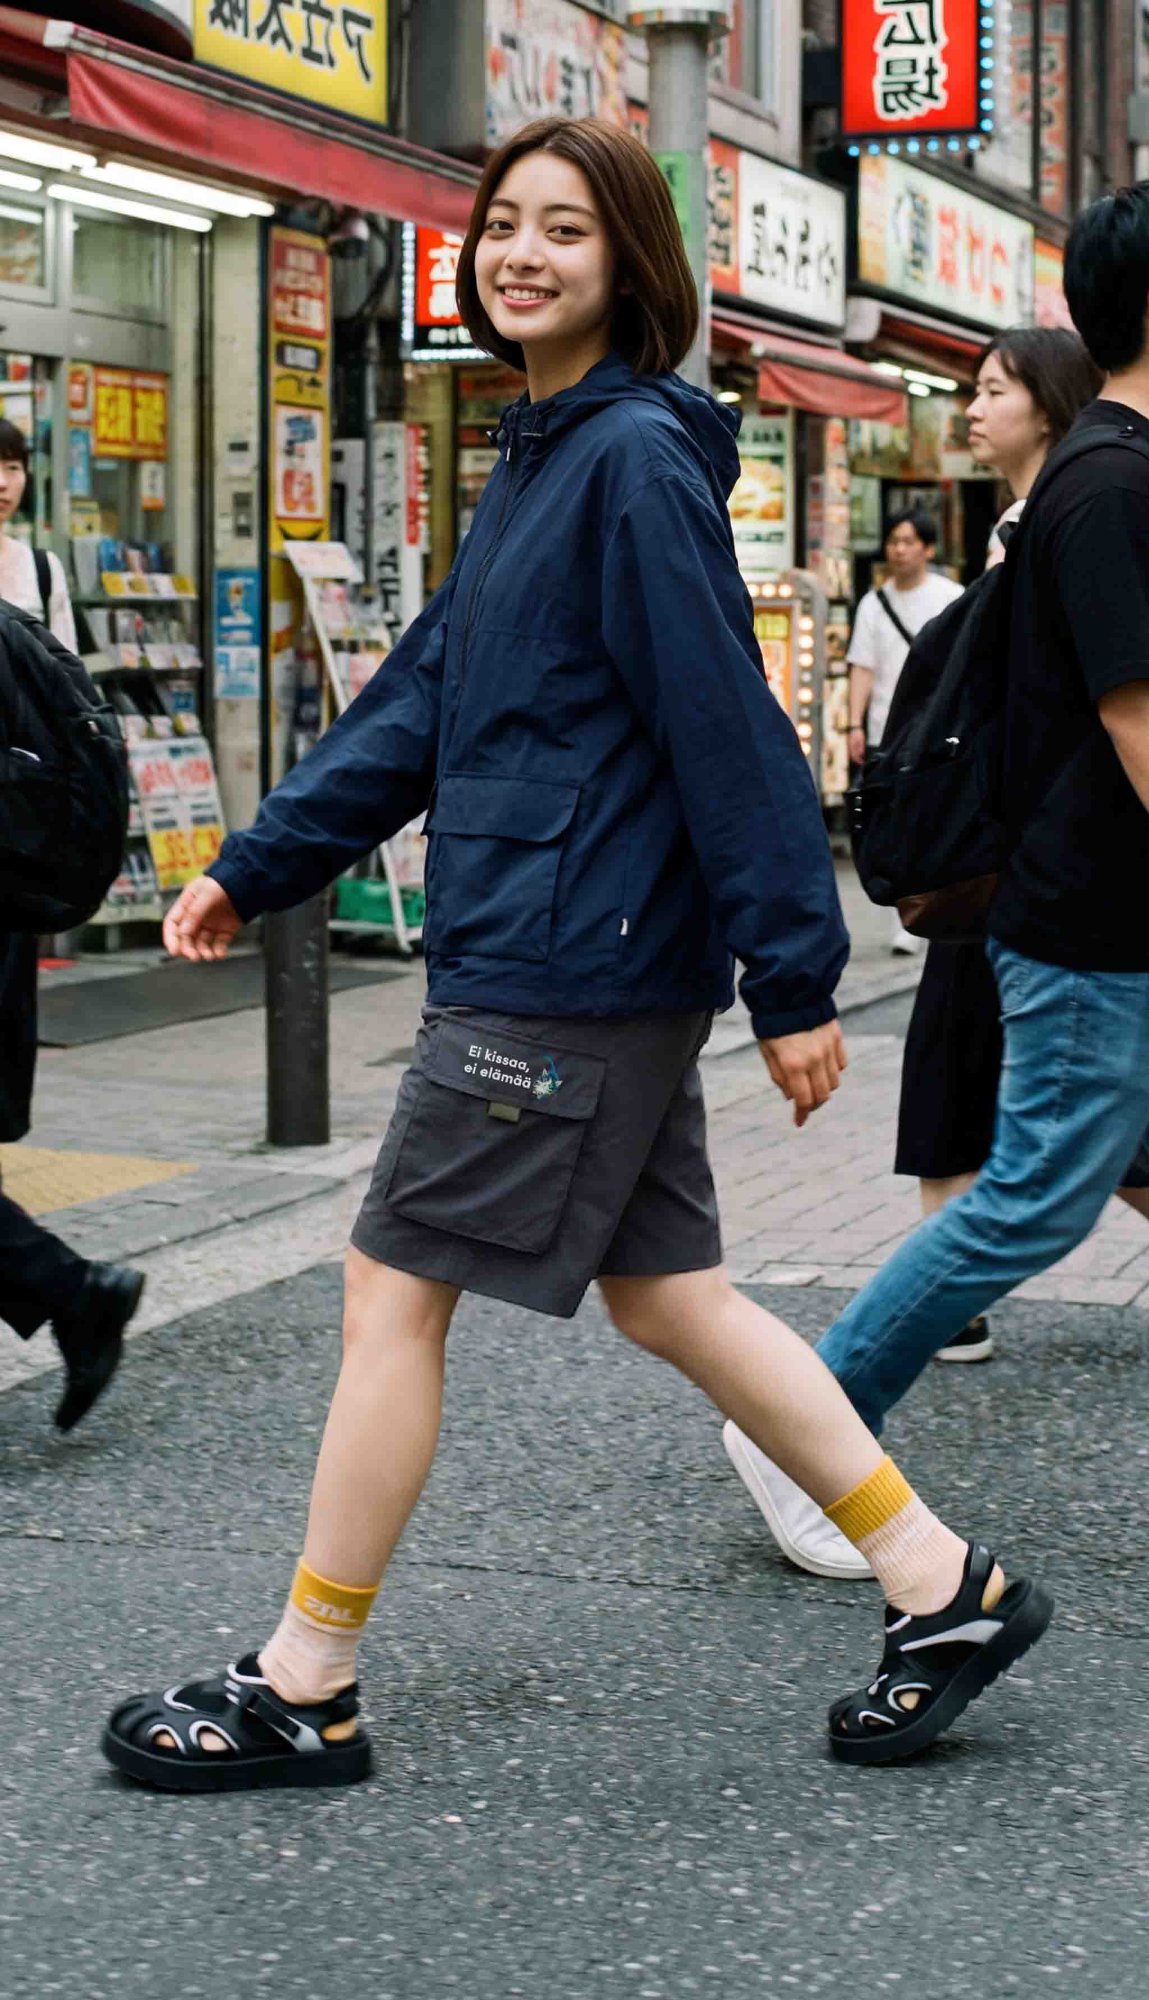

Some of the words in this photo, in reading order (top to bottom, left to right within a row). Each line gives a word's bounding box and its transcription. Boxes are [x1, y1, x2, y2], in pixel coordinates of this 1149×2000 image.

[468, 1045, 482, 1058] Ei
[484, 1048, 530, 1073] kissaa,
[464, 1063, 478, 1075] ei
[480, 1067, 532, 1089] elämää
